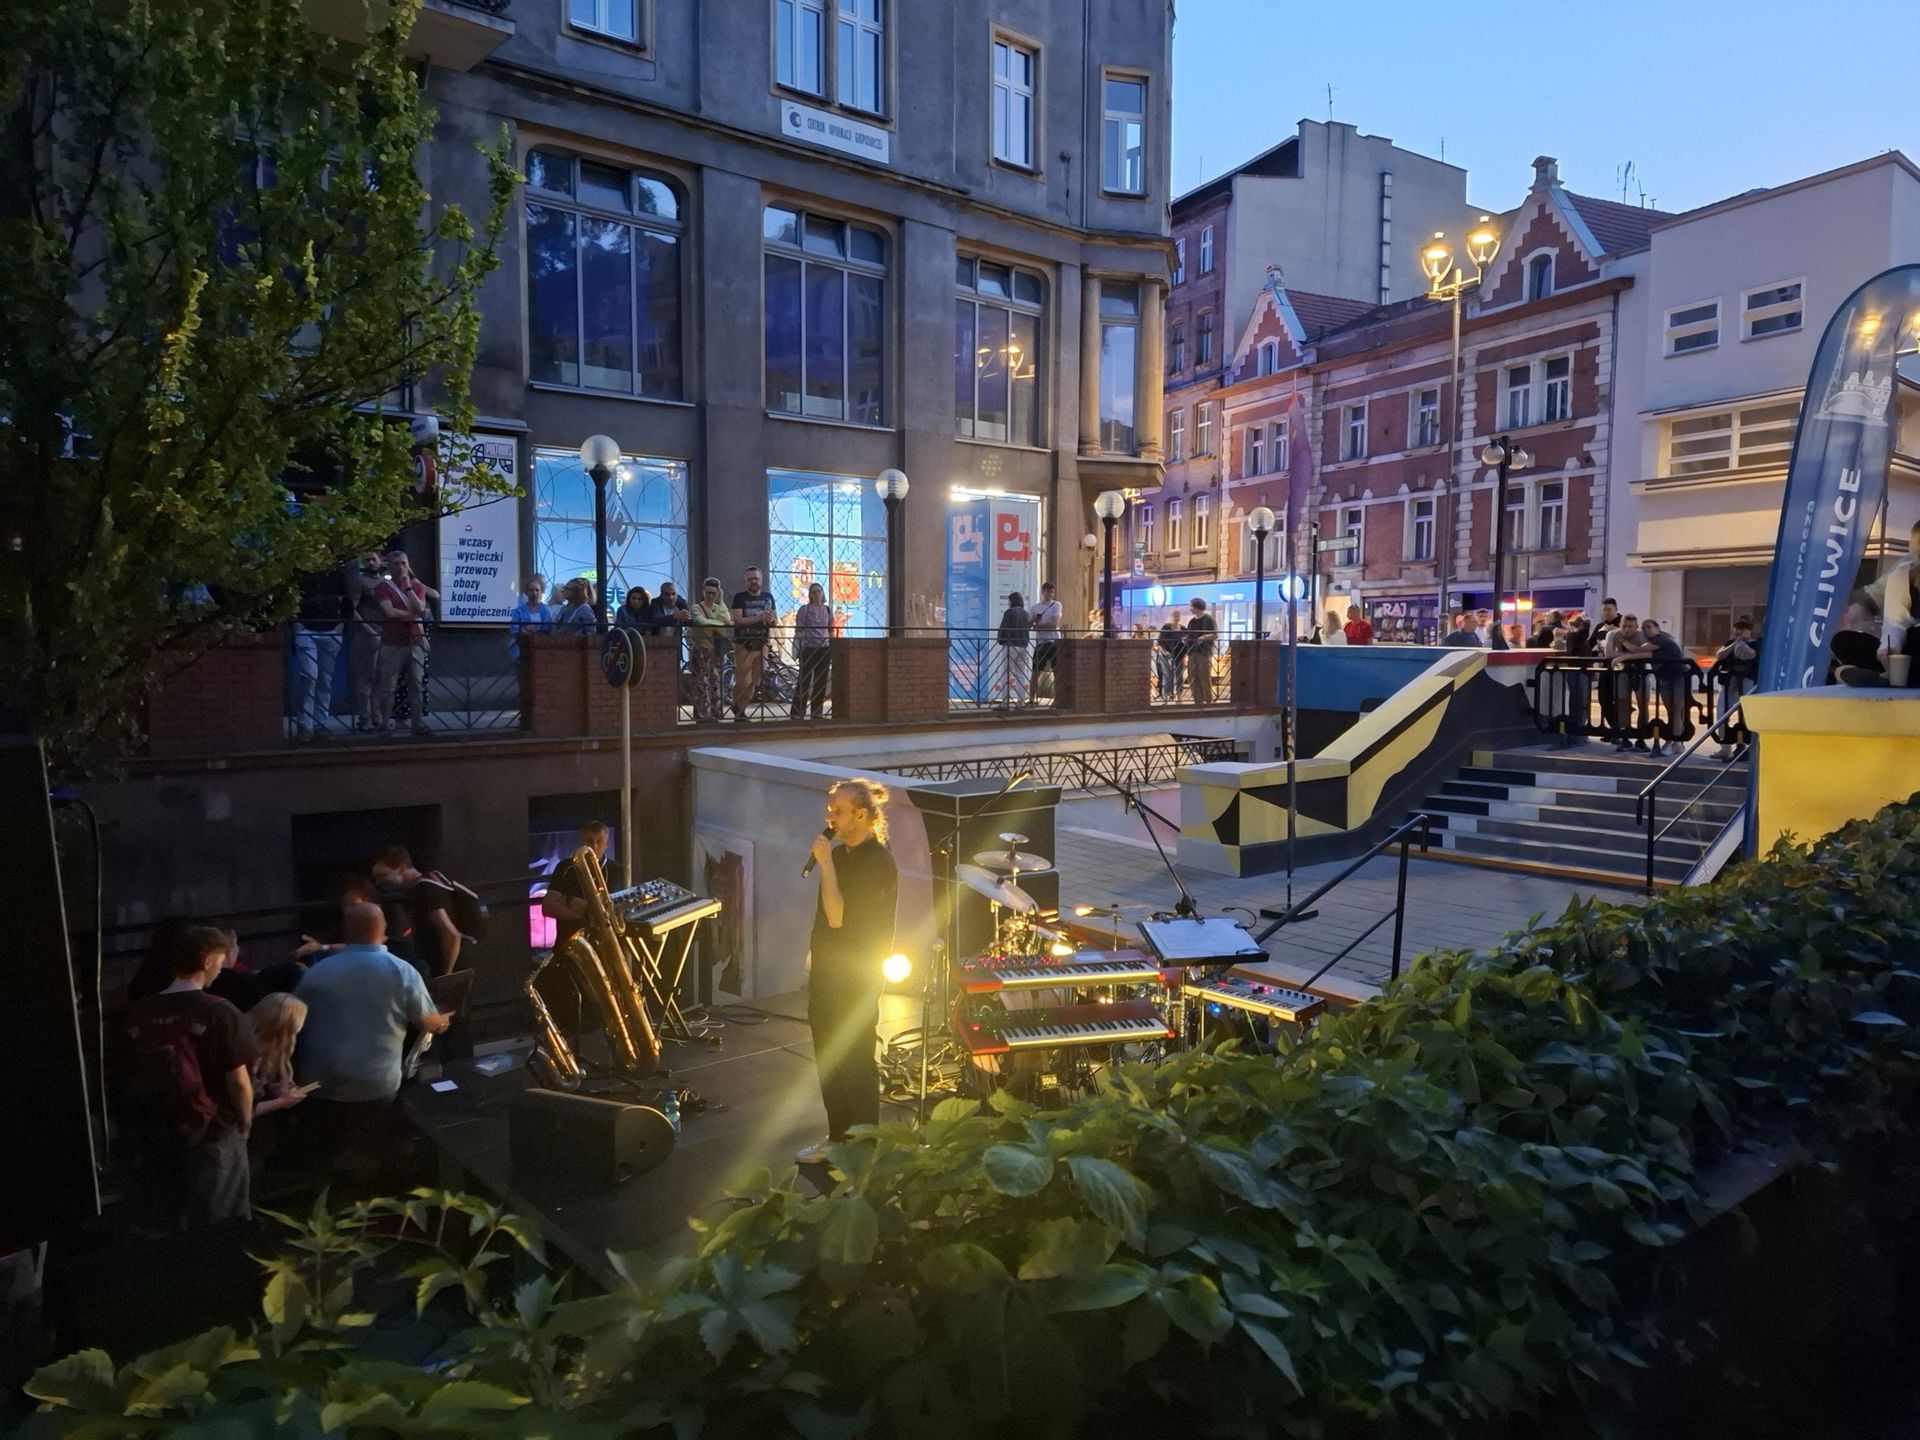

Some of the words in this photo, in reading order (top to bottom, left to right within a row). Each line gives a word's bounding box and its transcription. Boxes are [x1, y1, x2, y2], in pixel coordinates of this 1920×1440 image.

[458, 538, 493, 550] wczasy
[457, 551, 504, 563] wycieczki
[1808, 467, 1861, 648] GLIWICE
[454, 565, 498, 578] przewozy
[453, 577, 480, 591] obozy
[451, 591, 487, 603] kolonie
[1382, 602, 1407, 617] RAJ
